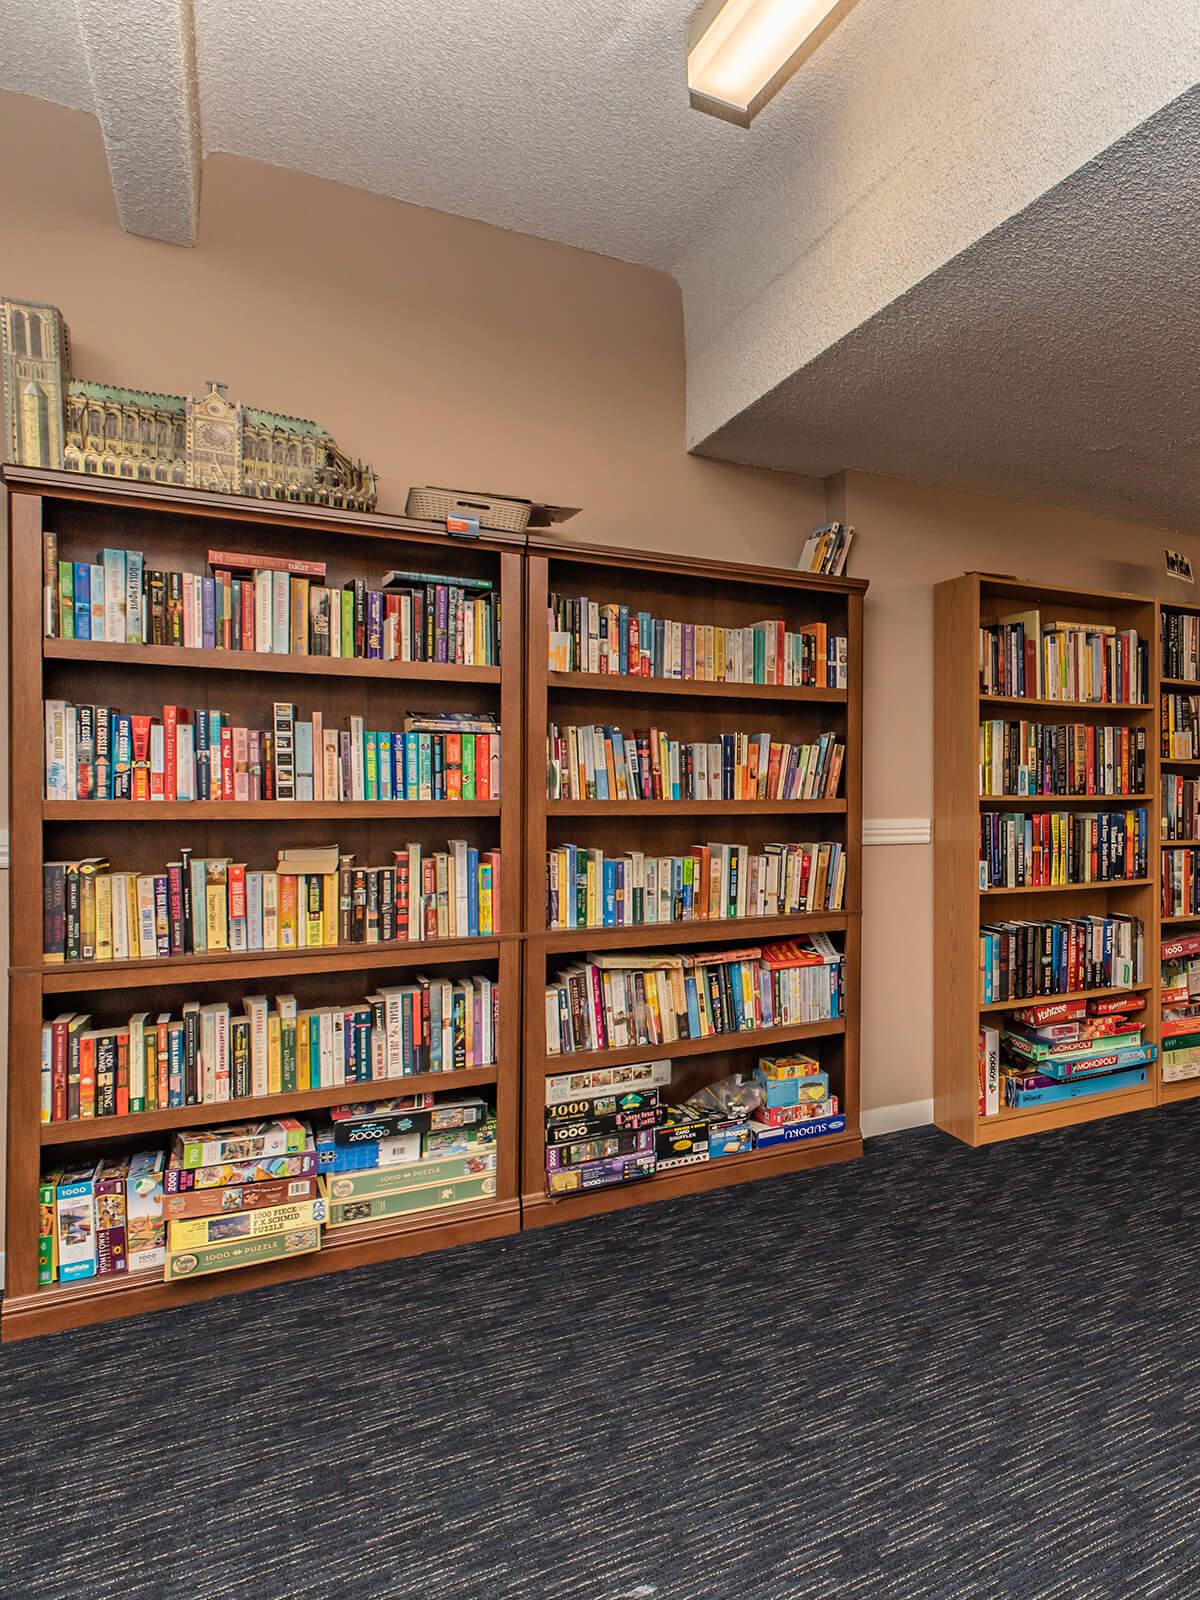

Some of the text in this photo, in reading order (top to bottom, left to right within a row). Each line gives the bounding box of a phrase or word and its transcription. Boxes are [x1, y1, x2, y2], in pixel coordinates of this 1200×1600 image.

[1165, 946, 1182, 954] 1000
[1037, 1004, 1067, 1021] Yahtzee
[1052, 1040, 1092, 1053] MONOPOLY
[1077, 1056, 1117, 1070] MONOPOLY
[550, 1102, 589, 1117] 1000
[554, 1126, 587, 1139] 1000
[784, 1124, 827, 1139] SUDOKU
[168, 1172, 177, 1192] 2000
[62, 1187, 86, 1196] 1000
